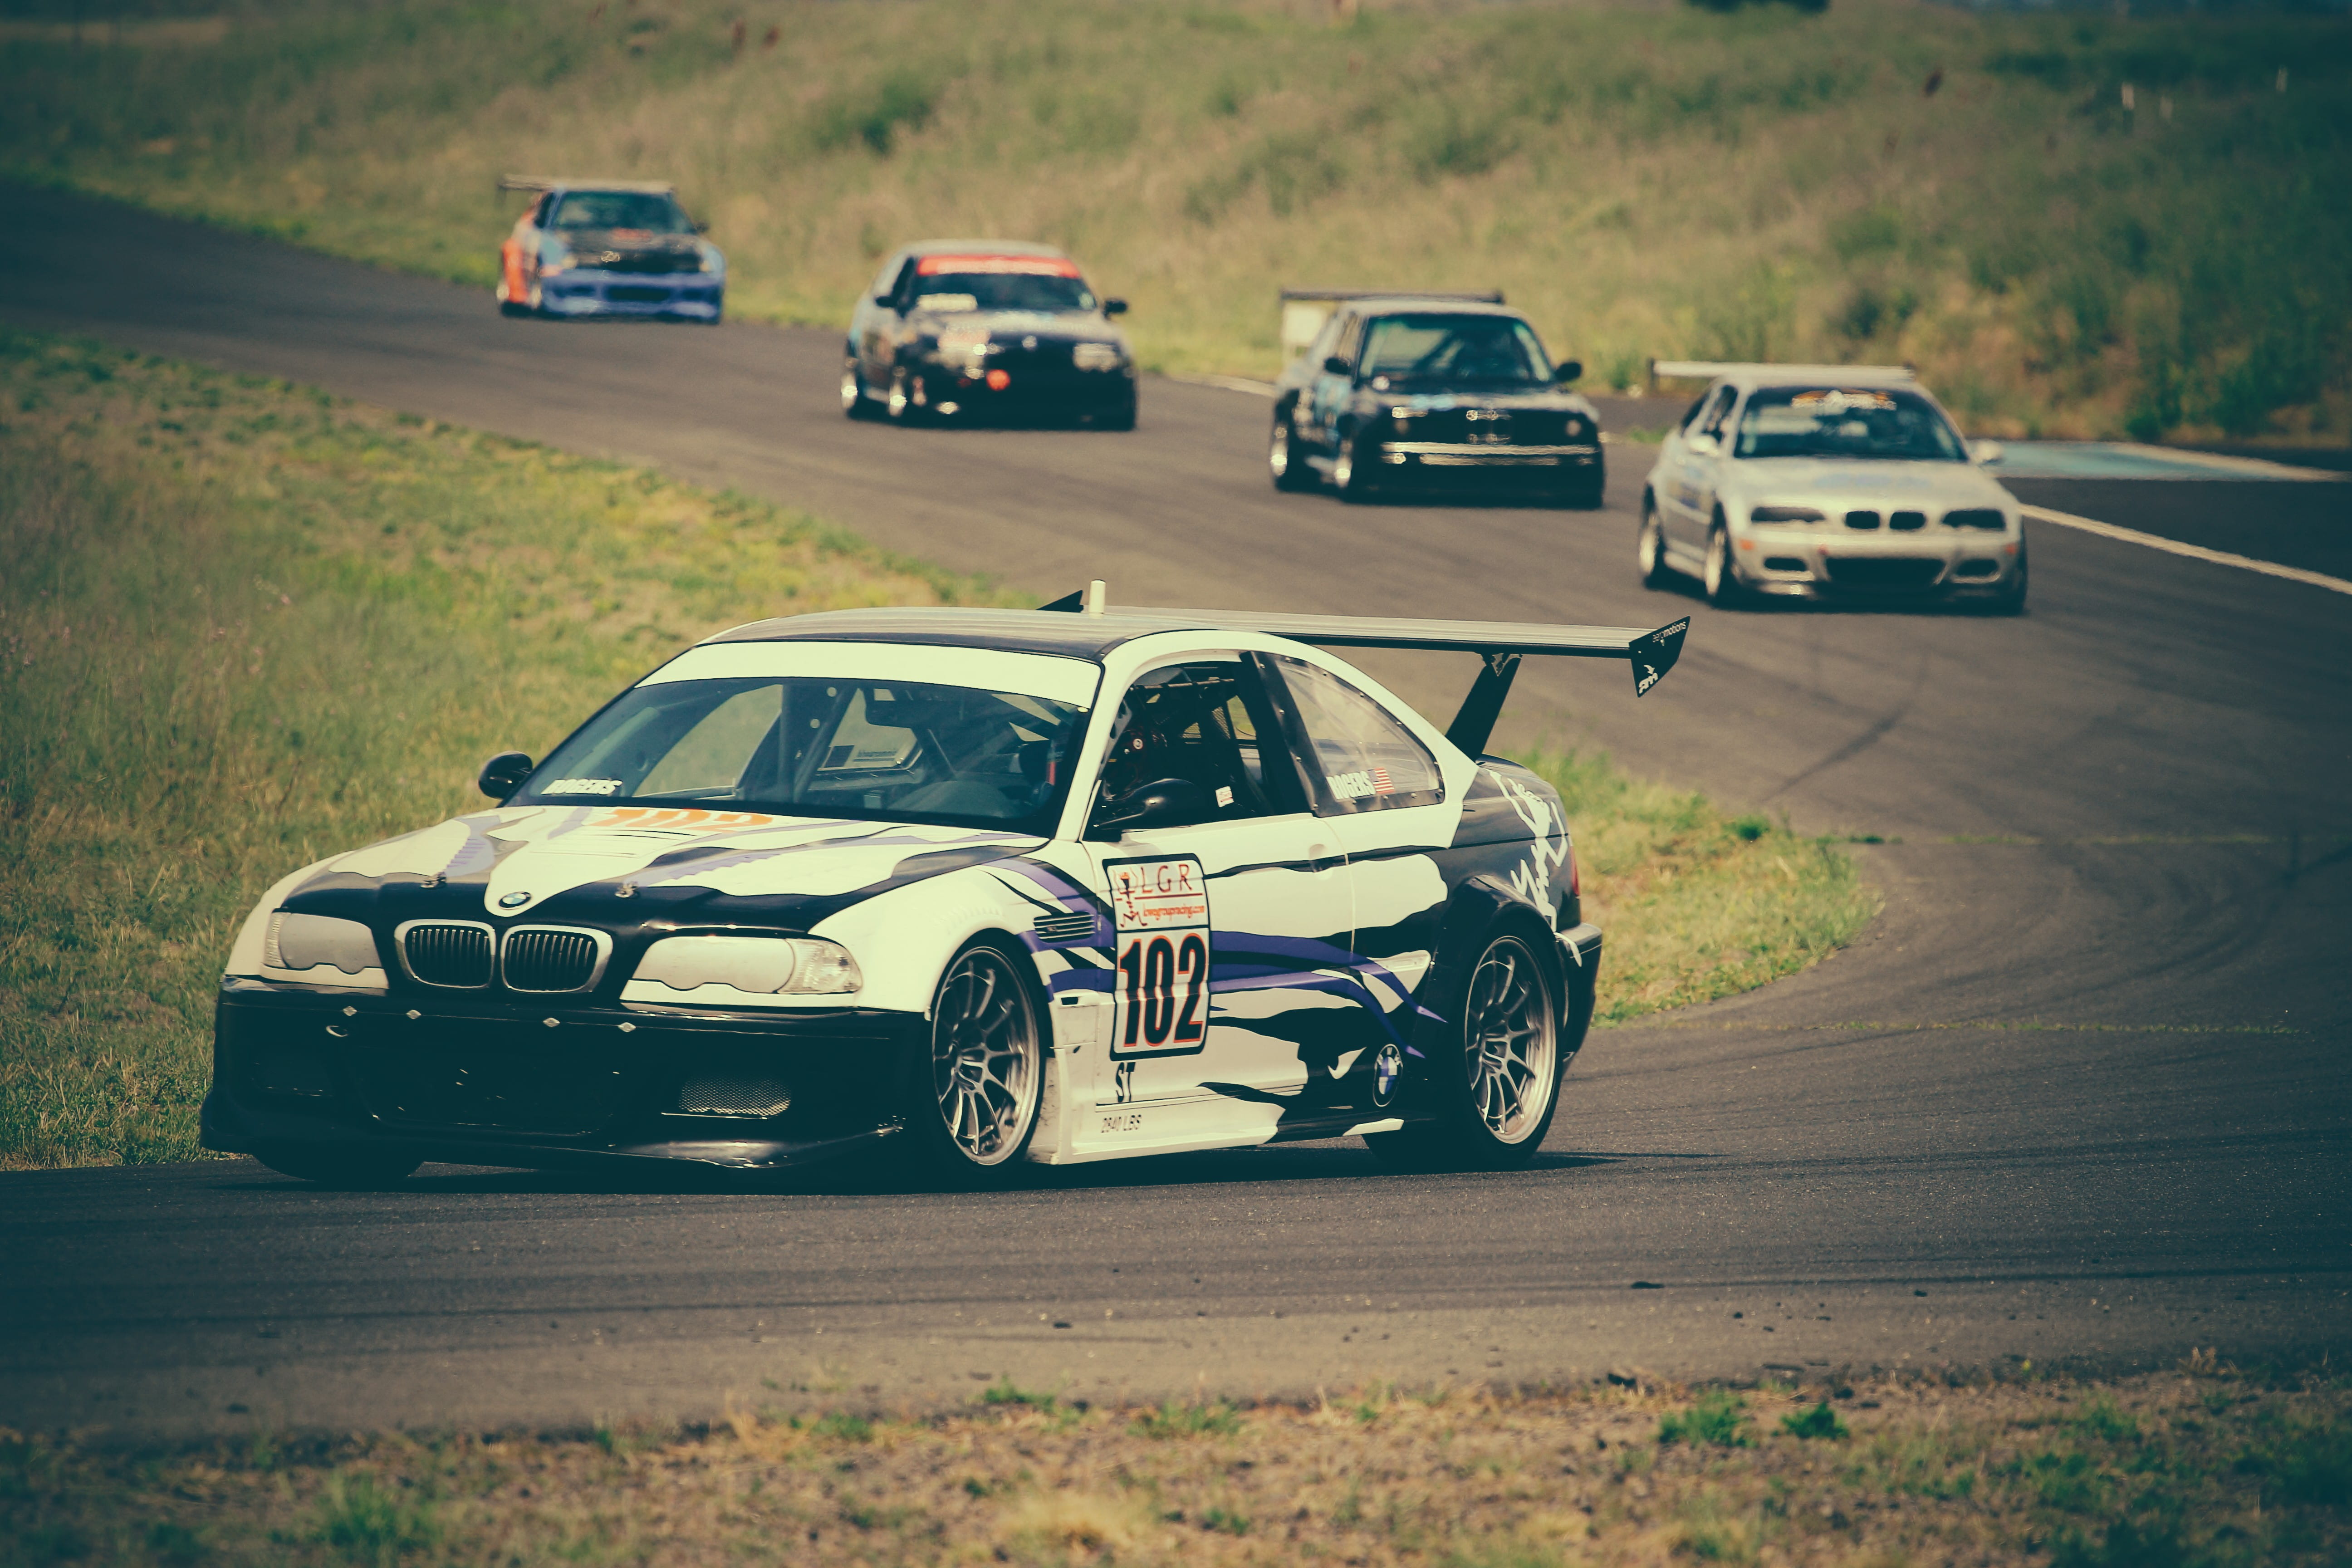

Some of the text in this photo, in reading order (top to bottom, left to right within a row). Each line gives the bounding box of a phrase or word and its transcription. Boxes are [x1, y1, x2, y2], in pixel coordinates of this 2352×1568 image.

[541, 779, 623, 795] ROGERS
[1326, 770, 1376, 800] ROGERS
[590, 808, 774, 833] 102
[1119, 932, 1206, 1047] 102
[1115, 1062, 1136, 1103] ST
